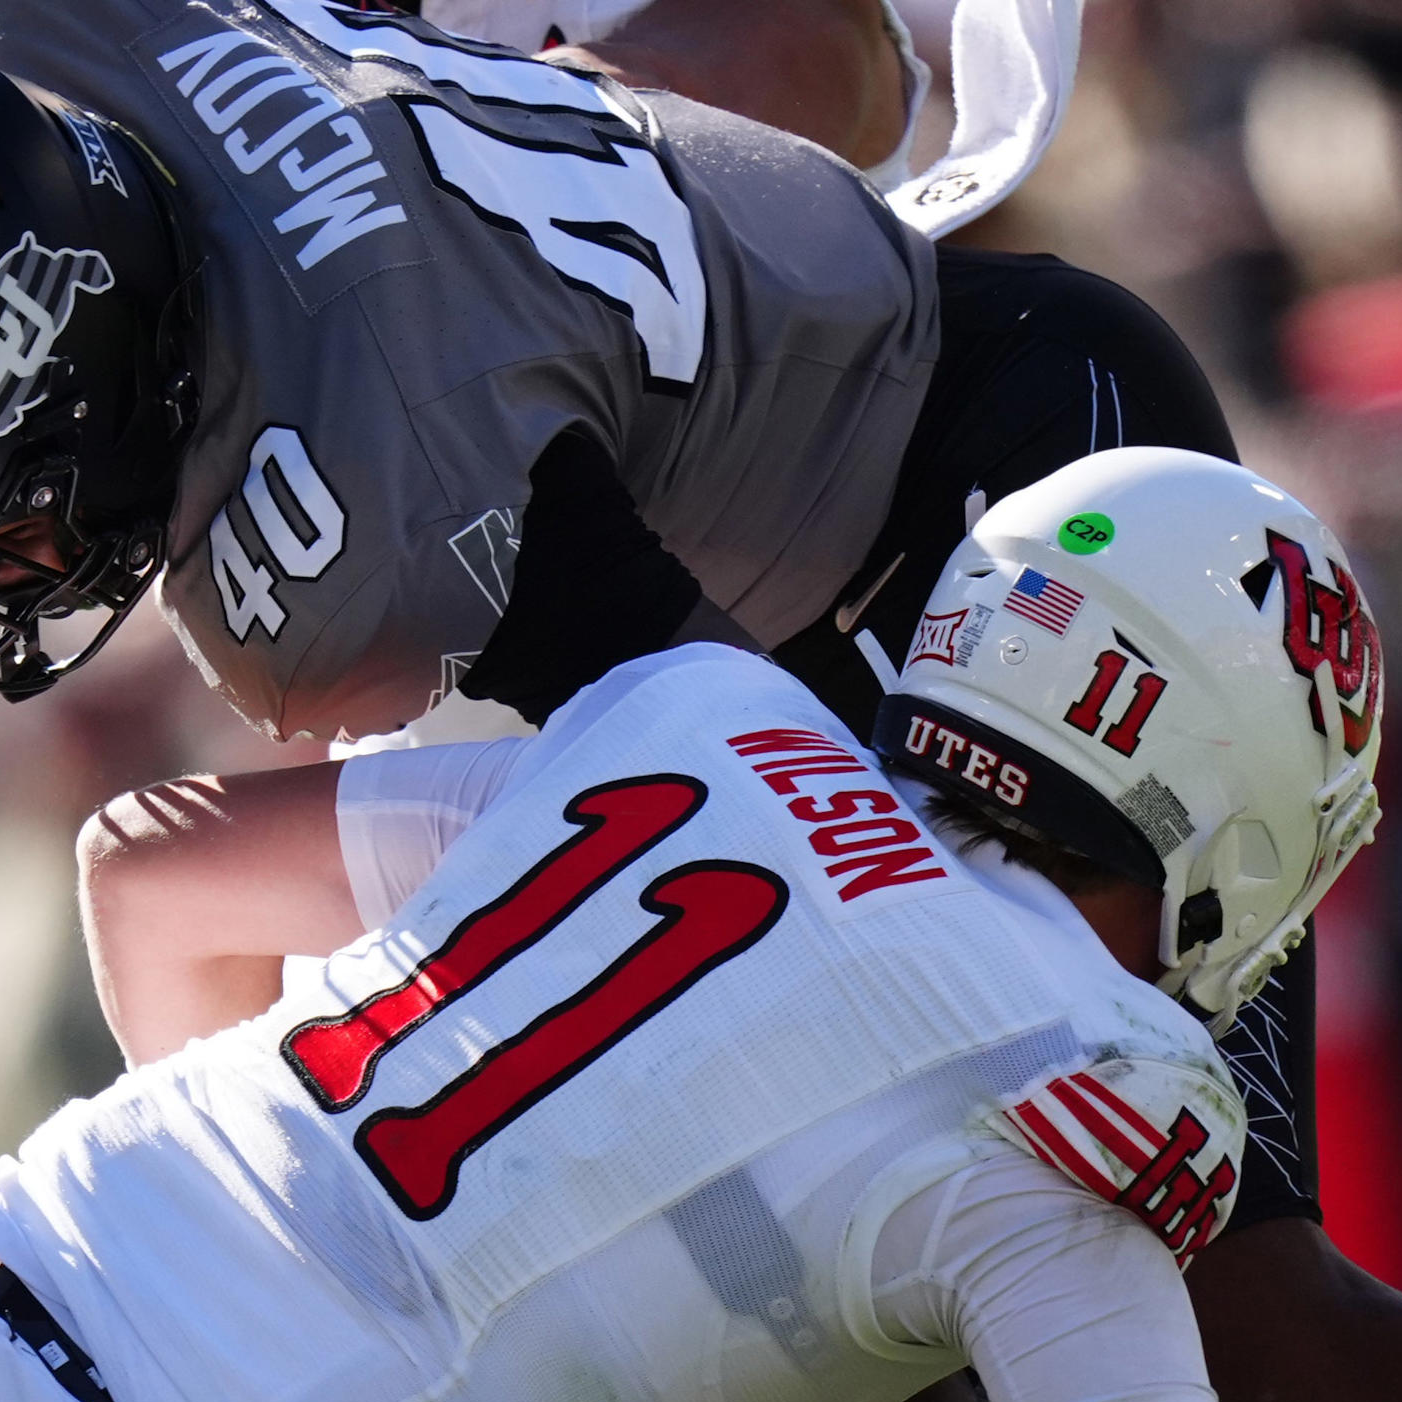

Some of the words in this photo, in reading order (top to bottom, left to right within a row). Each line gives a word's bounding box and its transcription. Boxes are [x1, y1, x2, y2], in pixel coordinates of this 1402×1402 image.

[208, 422, 350, 647] 40
[1066, 519, 1108, 543] C2P
[905, 714, 1032, 807] UTES
[1063, 649, 1169, 758] 11
[726, 728, 949, 903] WILSON
[279, 772, 790, 1221] 11
